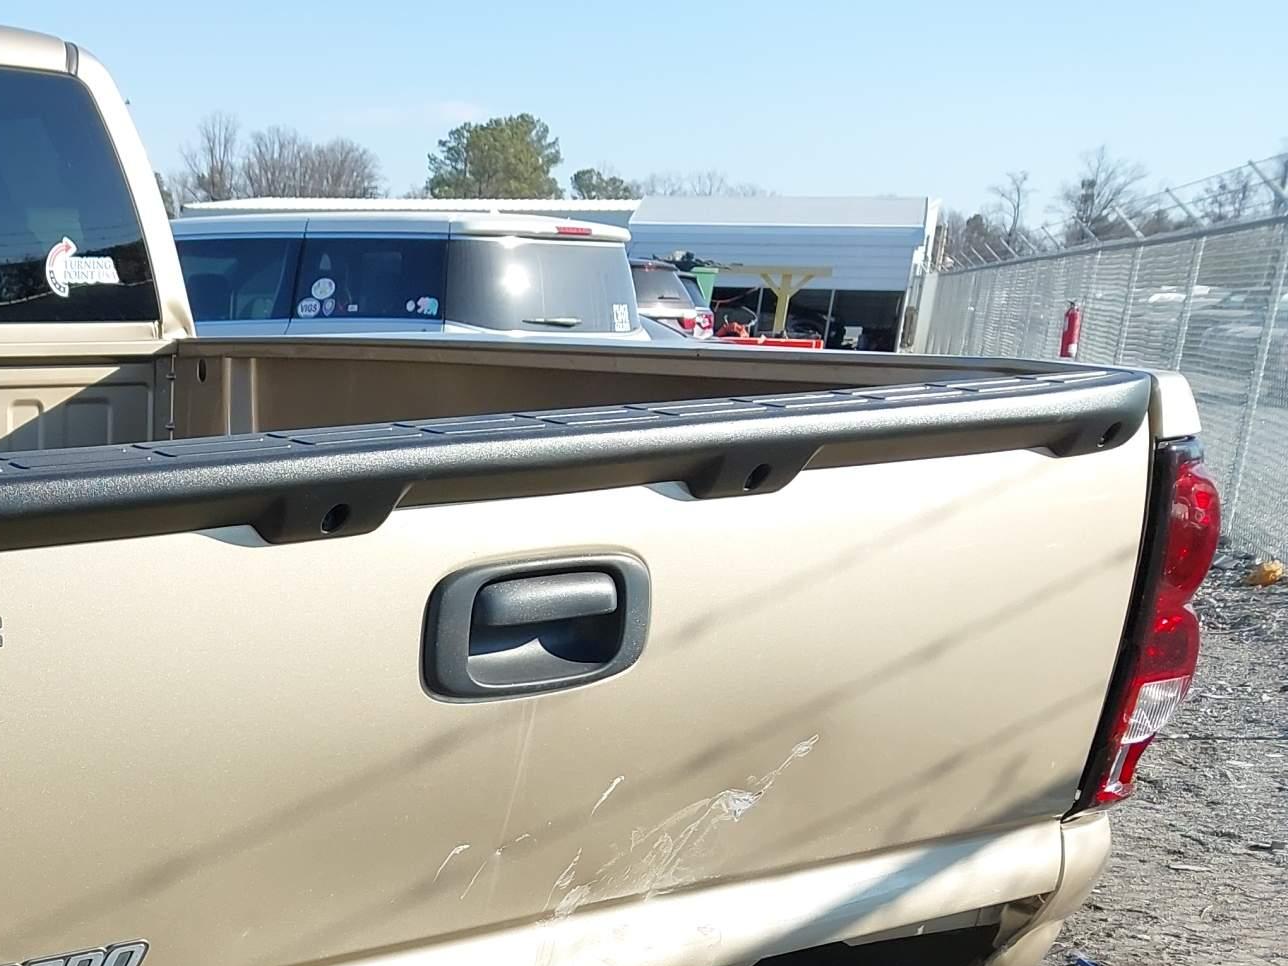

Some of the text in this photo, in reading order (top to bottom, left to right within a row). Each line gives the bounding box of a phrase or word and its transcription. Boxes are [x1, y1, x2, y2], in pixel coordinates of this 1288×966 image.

[63, 258, 112, 270] TURNING
[63, 271, 116, 281] POINT USA
